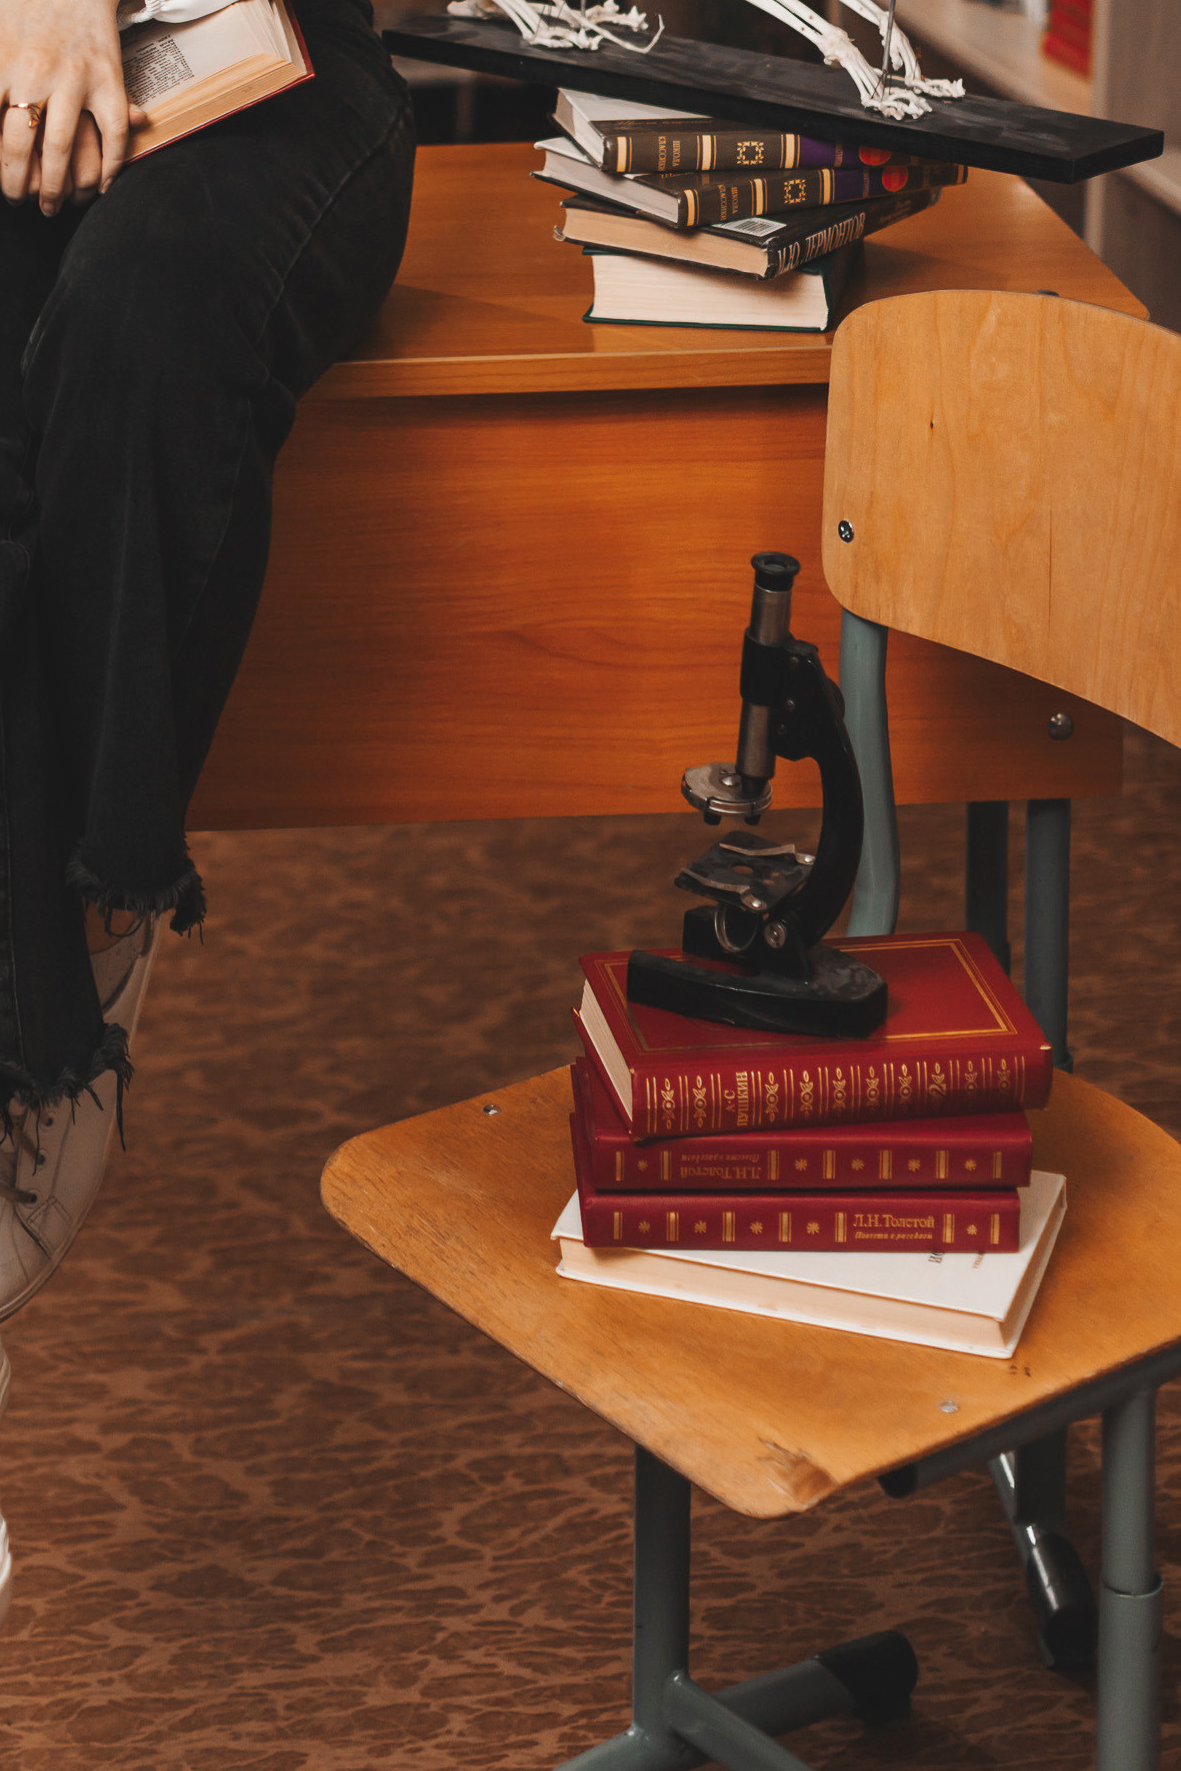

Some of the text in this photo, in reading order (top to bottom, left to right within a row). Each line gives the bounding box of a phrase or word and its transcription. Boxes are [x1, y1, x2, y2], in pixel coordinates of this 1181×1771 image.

[672, 140, 680, 167] ШКОЛА
[731, 186, 739, 214] ШКОЛА
[800, 211, 866, 266] ЛЕРМОНТОВ
[735, 1070, 749, 1126] ПУШКИН
